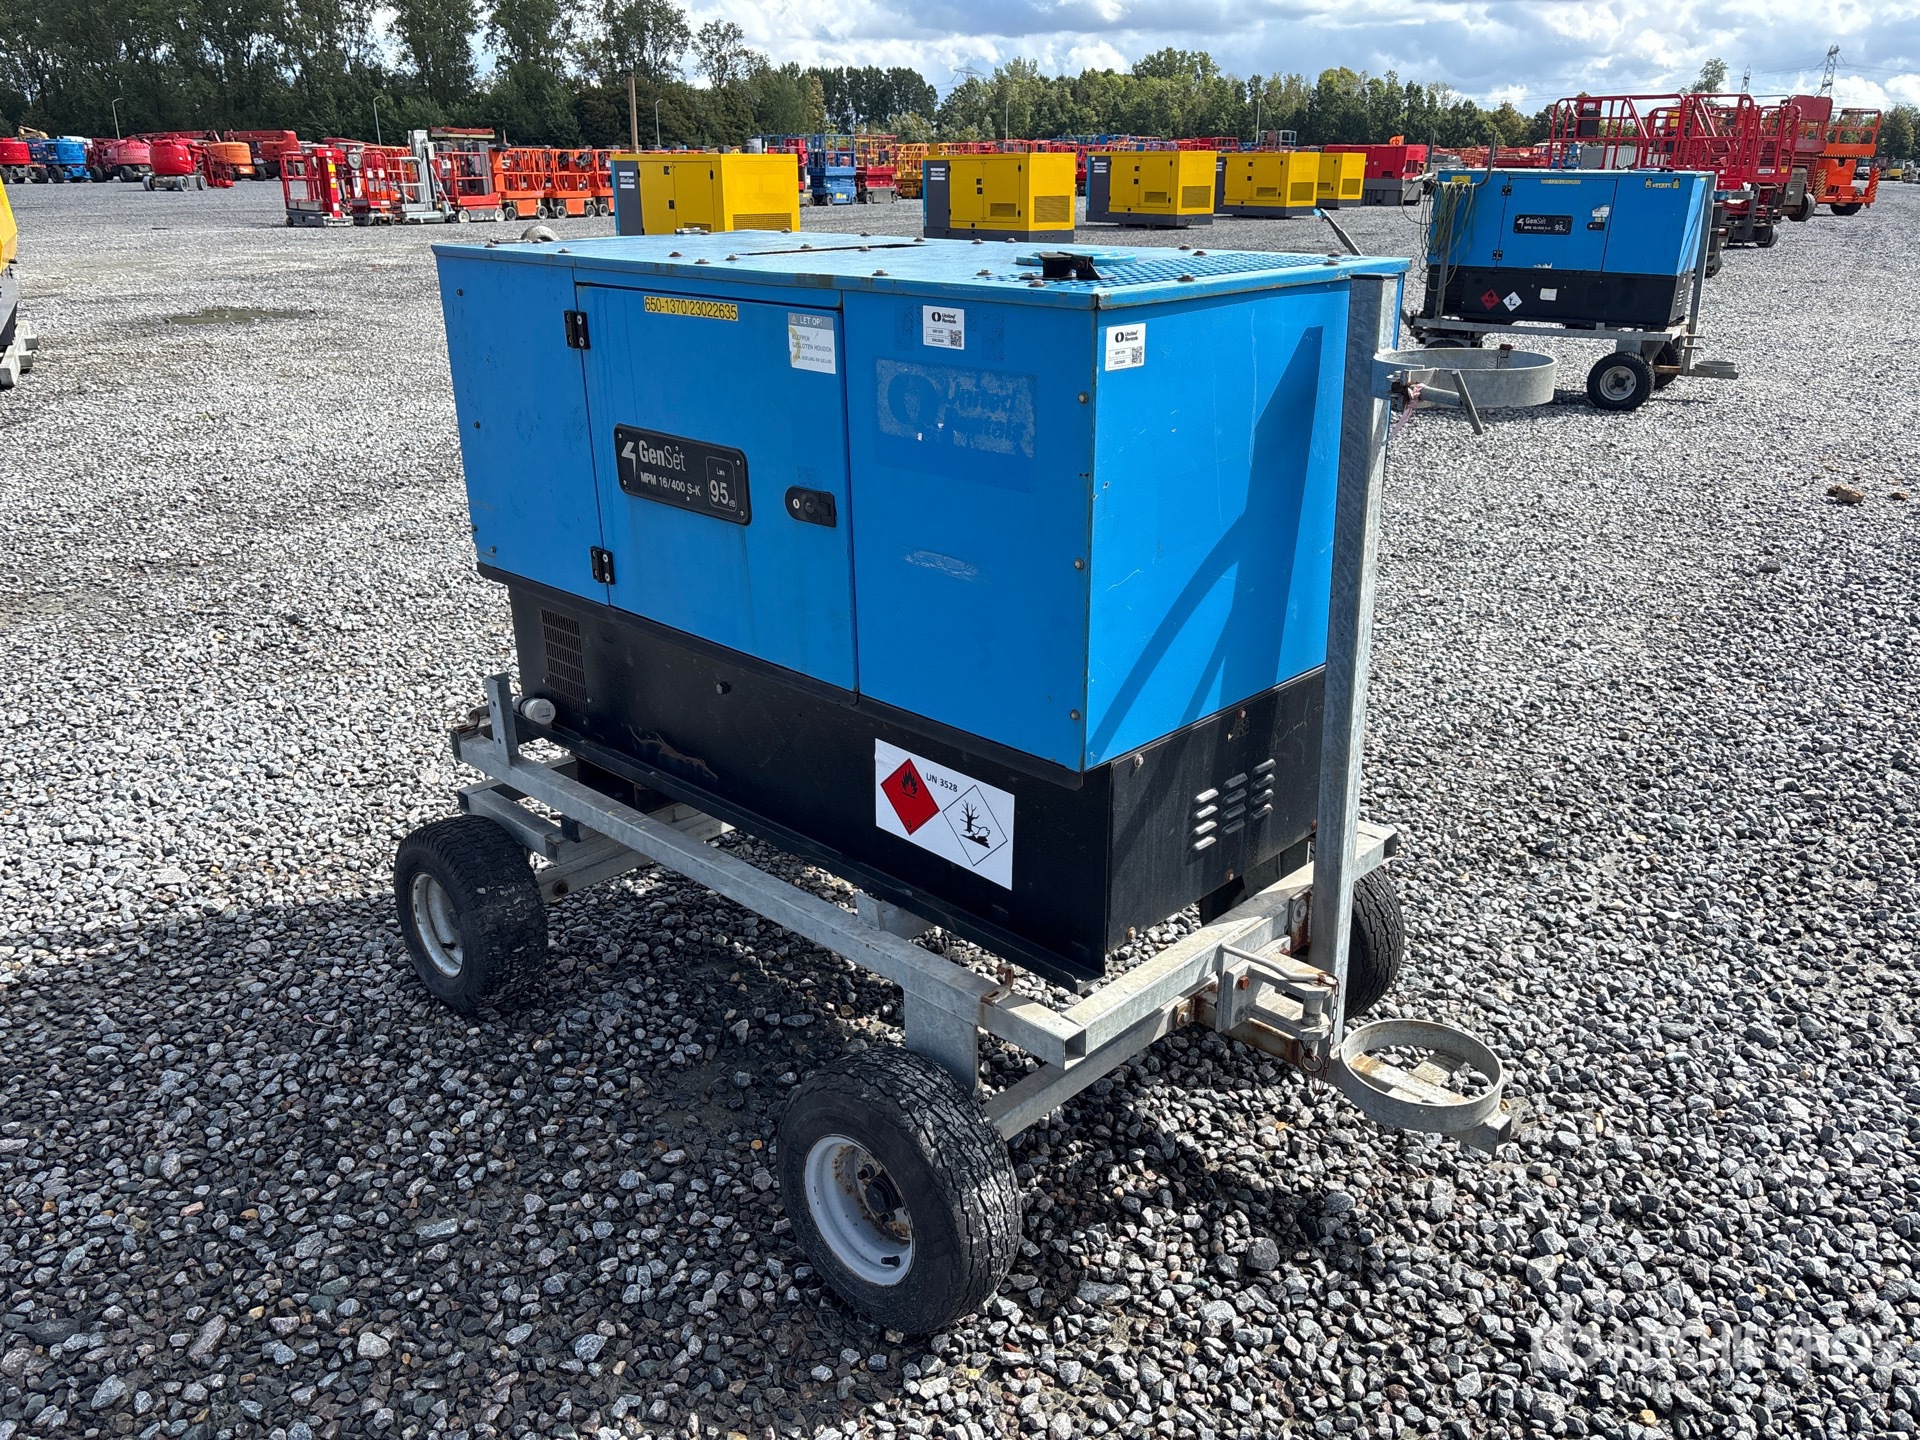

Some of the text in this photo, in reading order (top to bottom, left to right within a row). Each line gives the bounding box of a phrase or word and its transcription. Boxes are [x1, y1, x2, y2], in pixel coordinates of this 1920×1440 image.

[644, 297, 737, 320] 650-1370/23022635
[800, 316, 823, 327] LET OP!
[639, 440, 686, 472] GenSet
[640, 471, 701, 497] MPM 16/400 S-K
[710, 480, 729, 505] 95
[926, 772, 958, 793] UN 3528
[906, 819, 912, 829] 3
